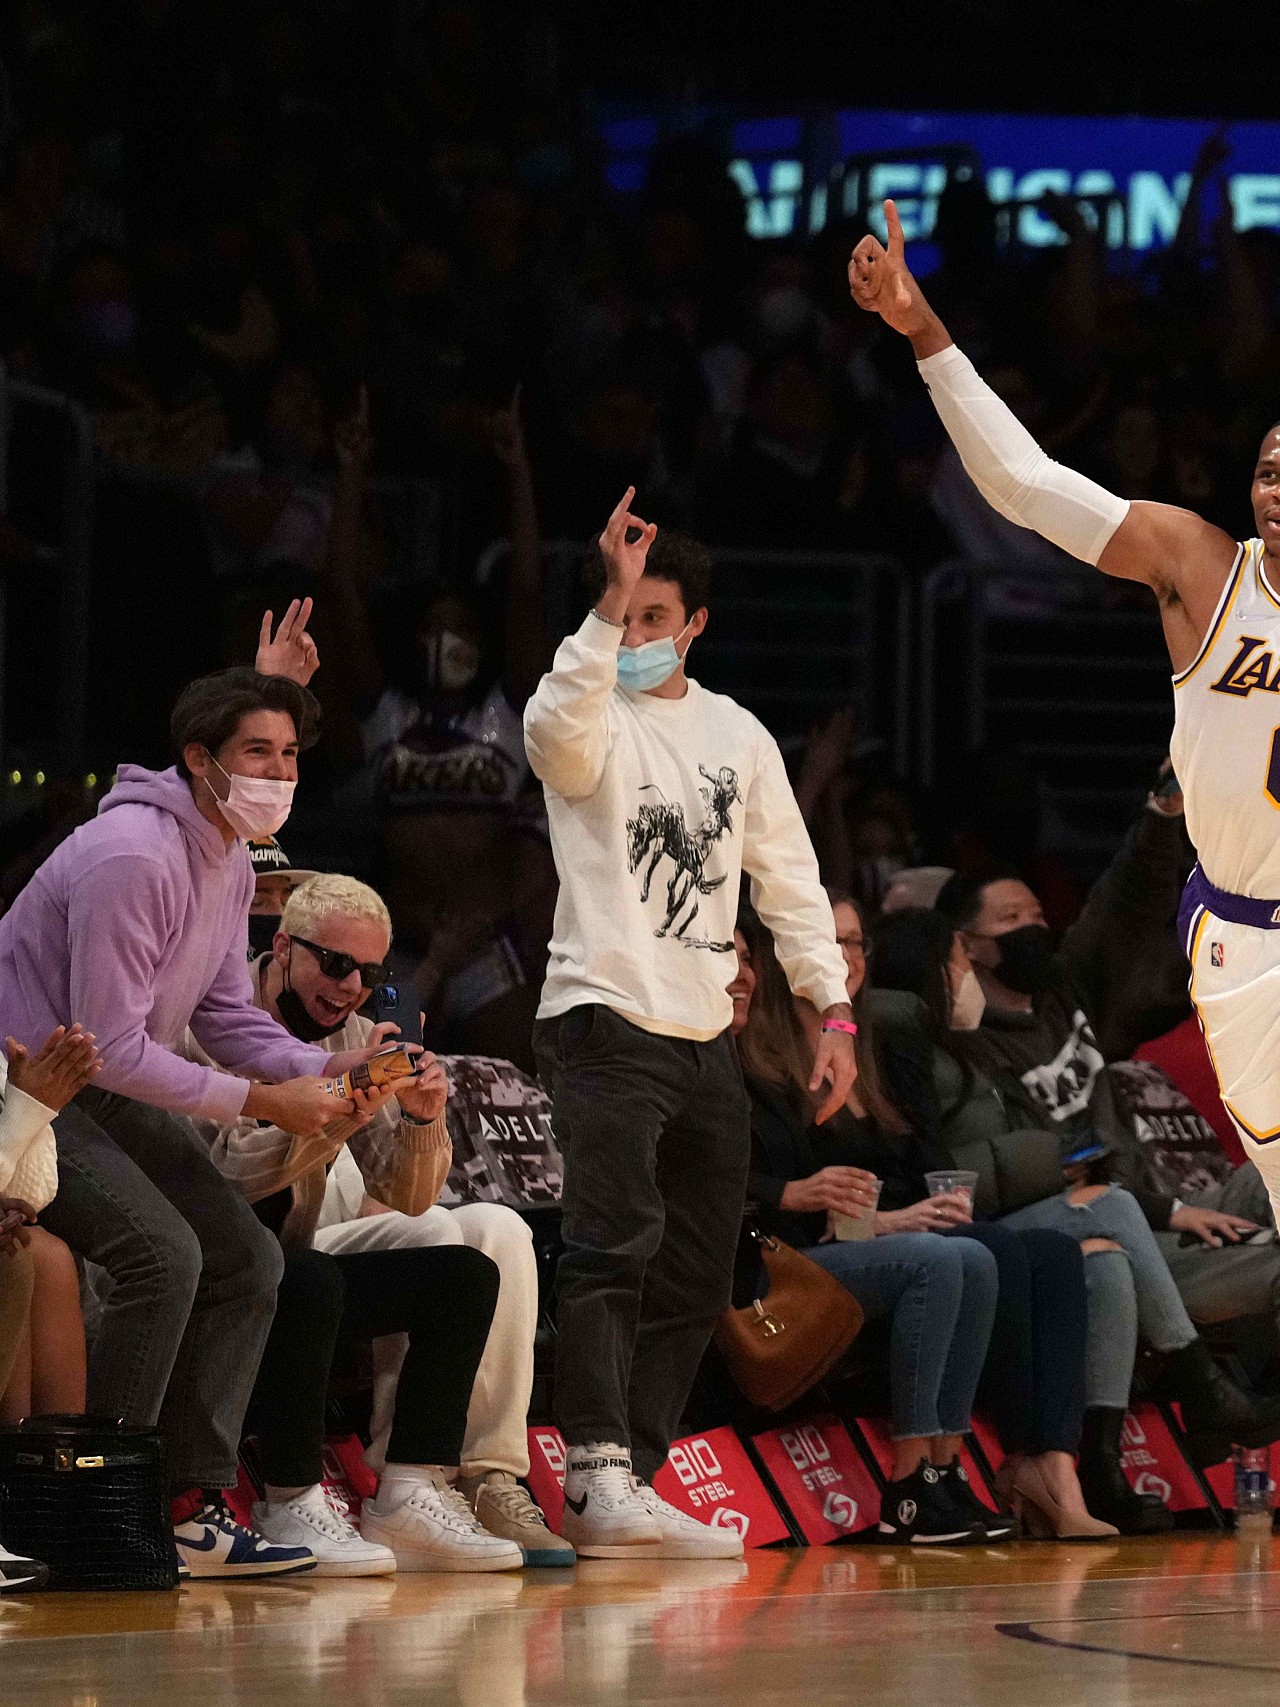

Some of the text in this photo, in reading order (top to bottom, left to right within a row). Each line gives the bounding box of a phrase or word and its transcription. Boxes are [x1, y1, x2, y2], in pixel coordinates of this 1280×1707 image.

[493, 1113, 556, 1142] DELT
[536, 1434, 566, 1471] BI
[668, 1439, 722, 1486] BIO
[780, 1425, 831, 1470] BIO
[687, 1481, 735, 1507] STEEL
[801, 1466, 843, 1491] STEEL
